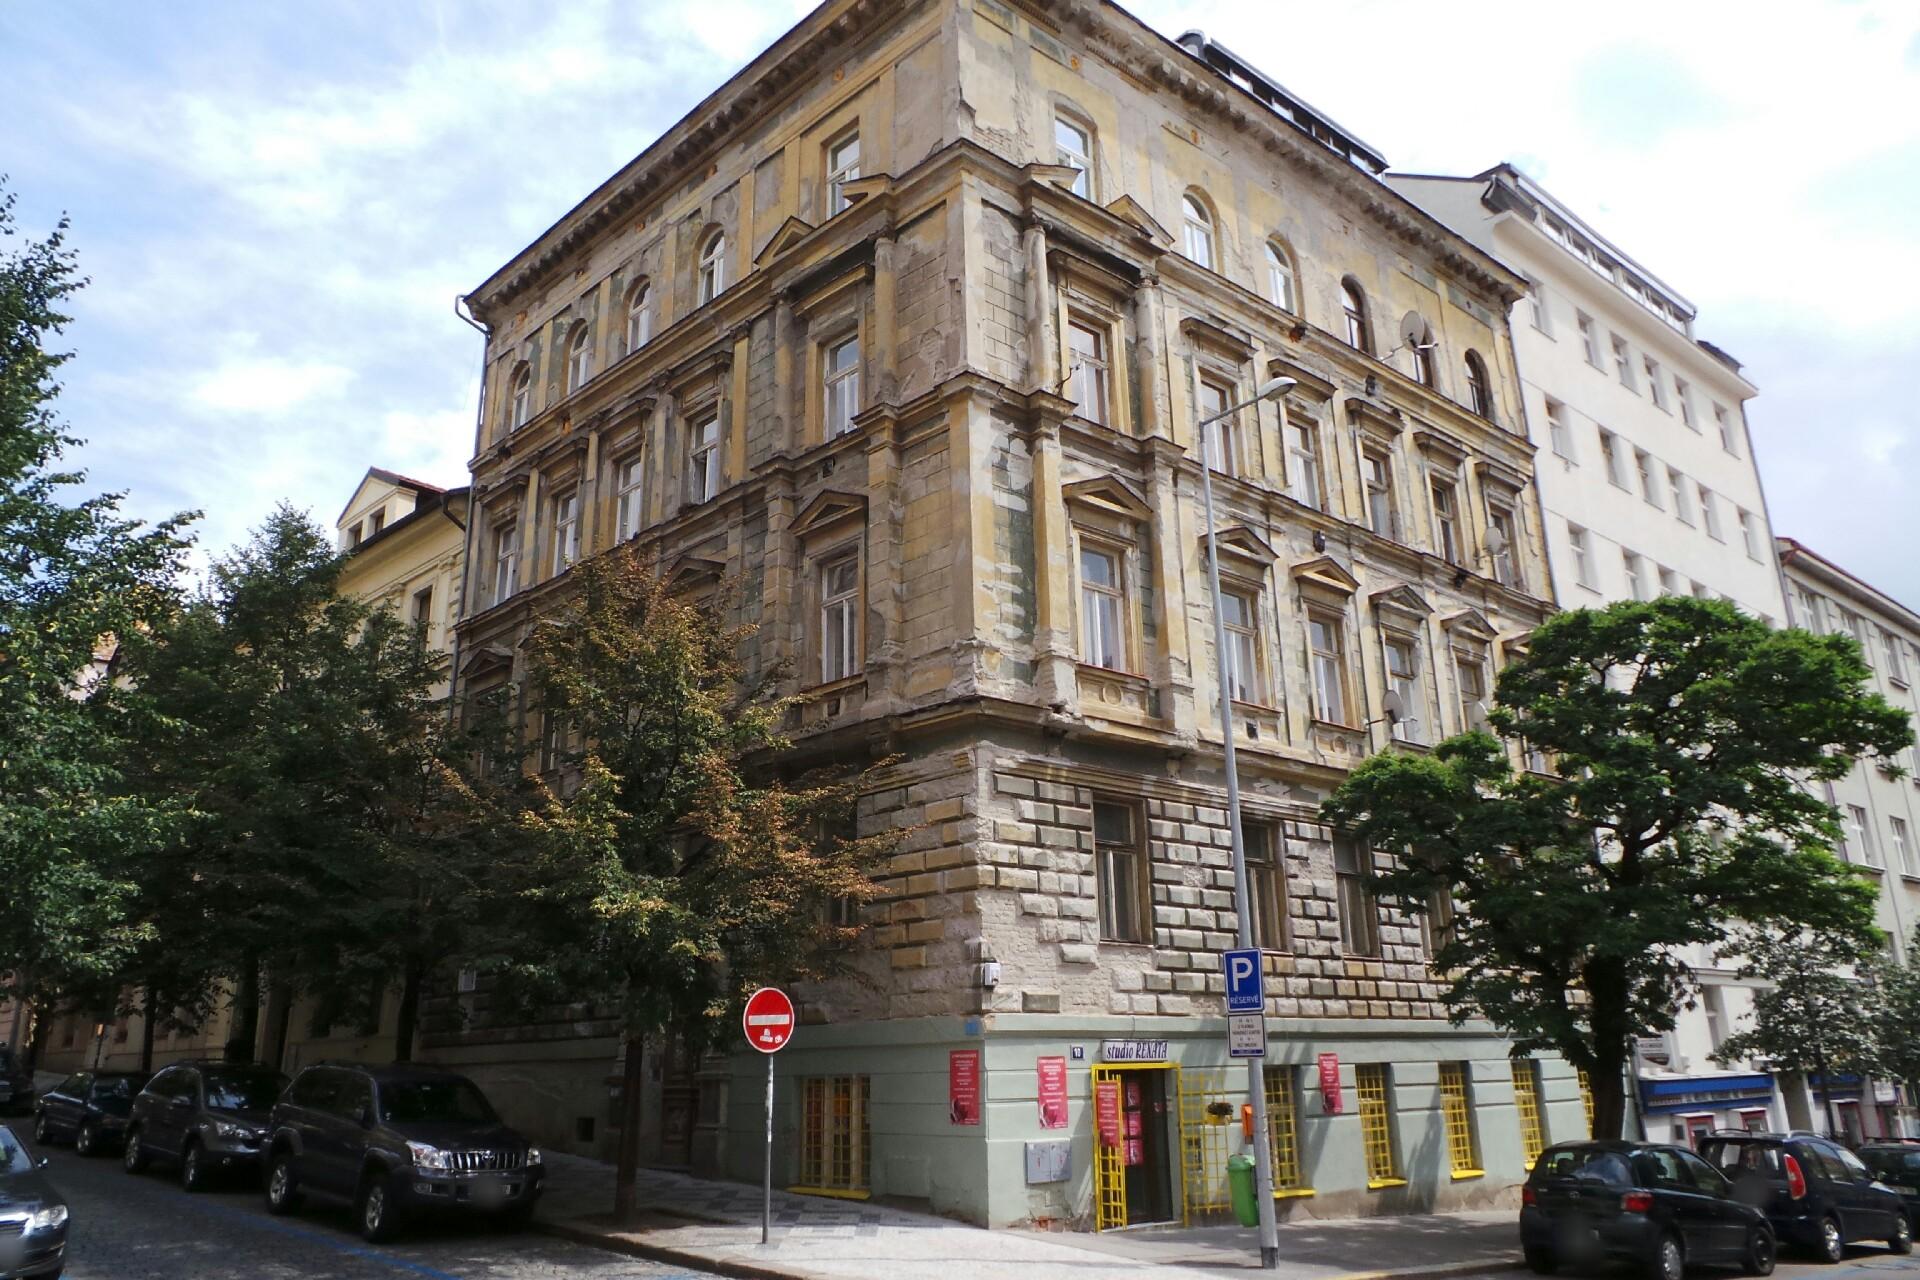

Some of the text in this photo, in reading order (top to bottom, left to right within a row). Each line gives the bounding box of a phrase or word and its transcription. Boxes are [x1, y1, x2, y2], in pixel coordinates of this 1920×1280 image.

[1231, 957, 1253, 992] P
[1107, 1040, 1168, 1059] studio RENATA
